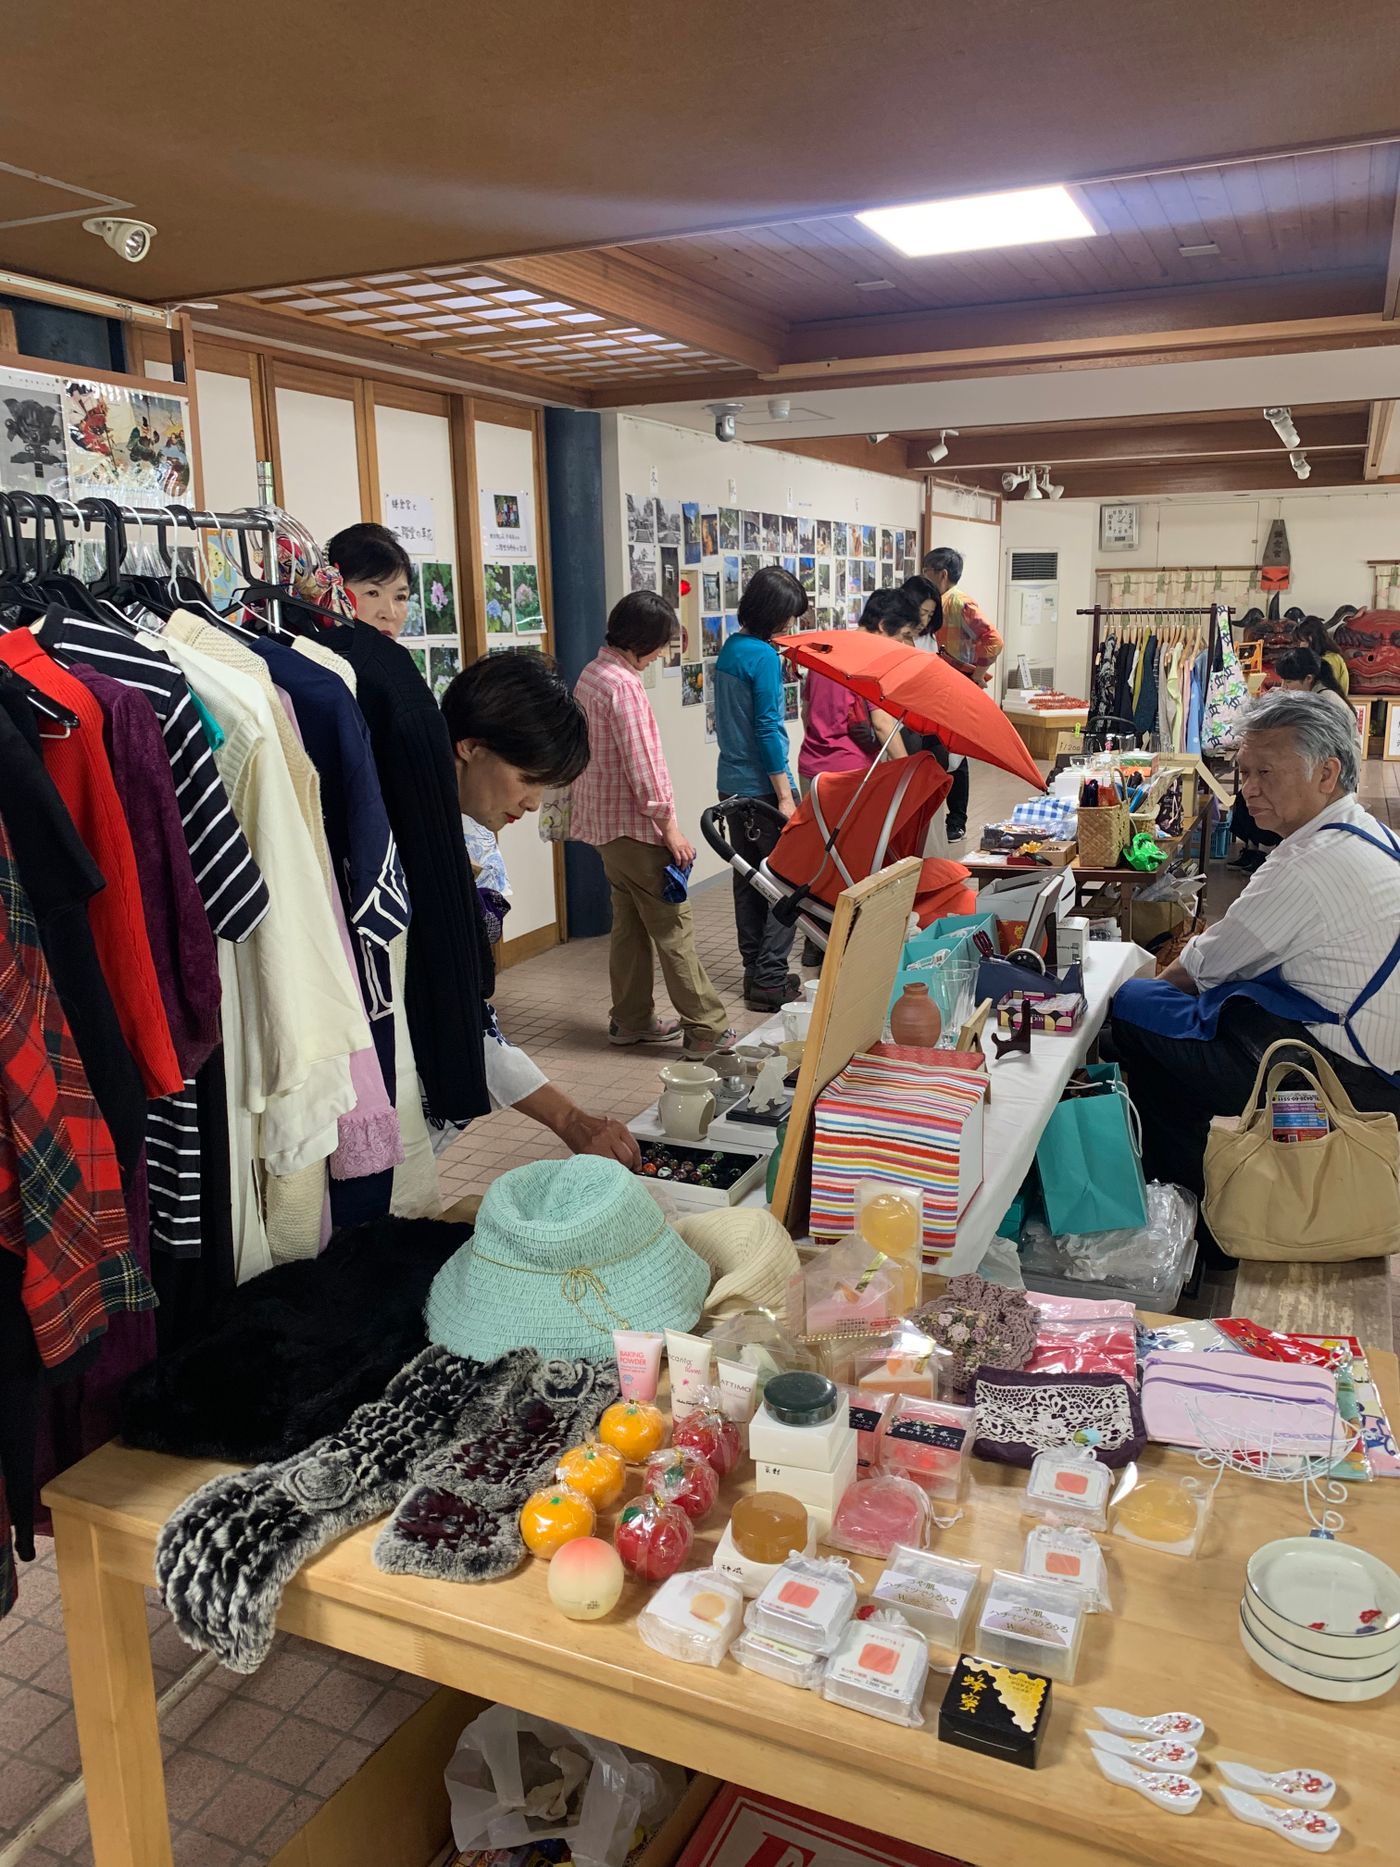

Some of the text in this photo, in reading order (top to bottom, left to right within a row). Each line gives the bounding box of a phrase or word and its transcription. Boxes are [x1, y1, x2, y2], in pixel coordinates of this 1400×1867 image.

[619, 1350, 644, 1358] BAKING
[619, 1357, 647, 1366] POWDER
[720, 1378, 751, 1393] ATTIMO
[907, 1578, 936, 1591] つや肌
[884, 1580, 958, 1606] ハチミツでうるうる
[1012, 1605, 1044, 1618] つや肌
[990, 1609, 1069, 1633] ハチミツでうるうる
[959, 1674, 987, 1713] 蜂蜜
